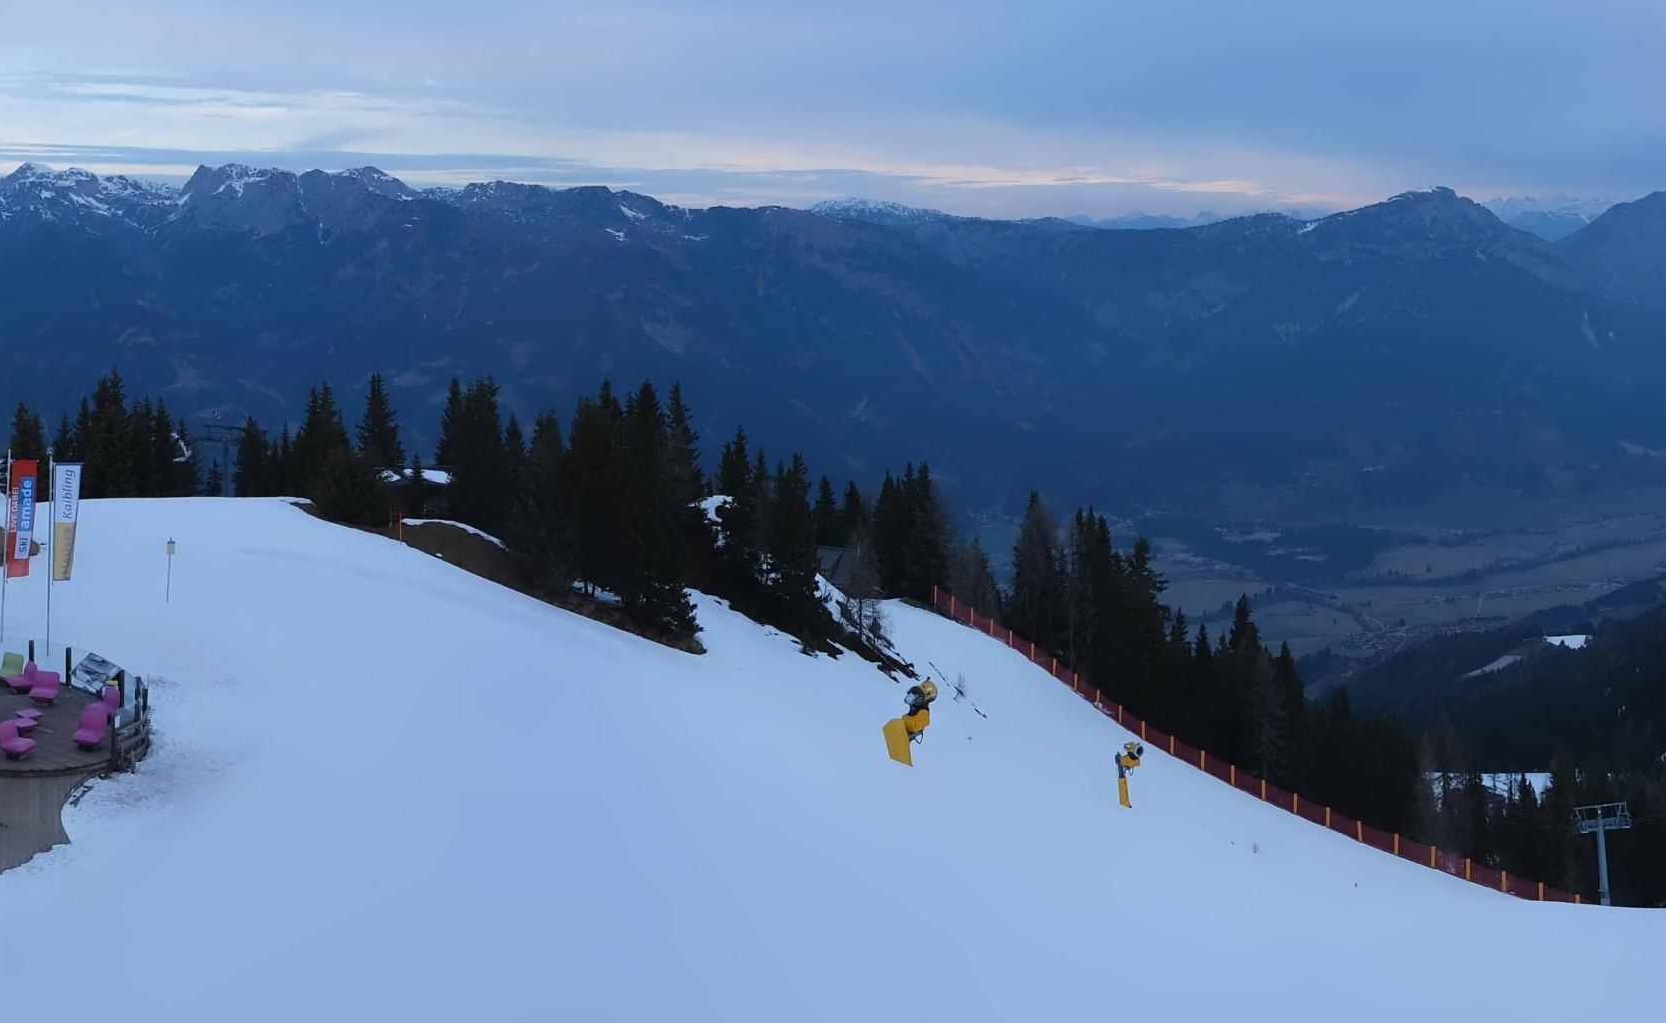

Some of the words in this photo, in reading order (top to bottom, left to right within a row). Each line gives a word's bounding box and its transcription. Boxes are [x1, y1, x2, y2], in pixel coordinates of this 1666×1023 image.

[11, 486, 19, 509] DABEI
[20, 480, 33, 529] amade
[62, 469, 76, 520] Kaibling
[10, 510, 18, 533] LIVE
[18, 535, 28, 554] Ski
